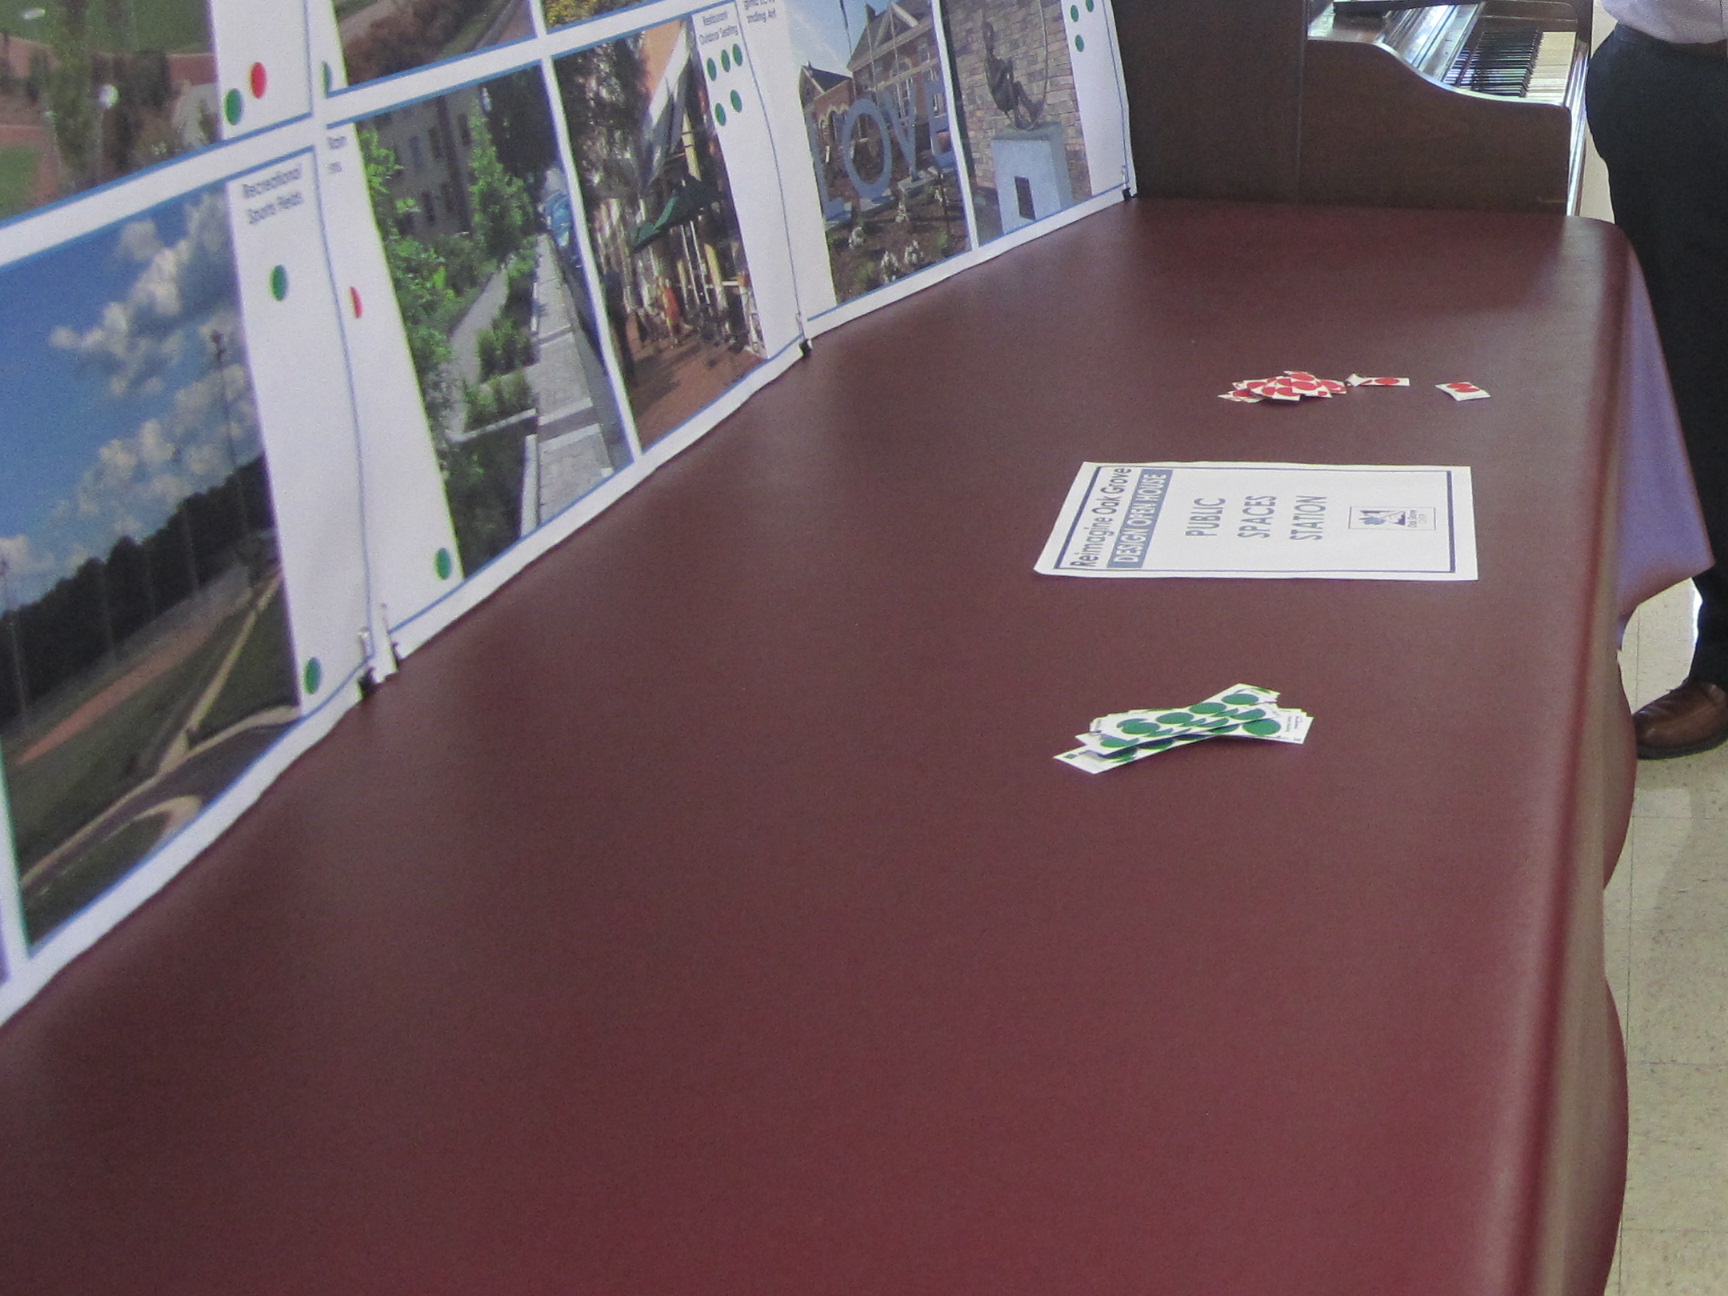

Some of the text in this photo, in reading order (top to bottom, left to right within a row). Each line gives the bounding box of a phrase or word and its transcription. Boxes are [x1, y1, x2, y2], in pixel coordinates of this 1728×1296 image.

[1070, 468, 1132, 567] Reimagine Oak Grove
[1113, 473, 1167, 562] DESIGN OPEN HOUSE
[1184, 497, 1226, 537] PUBLIC
[1236, 495, 1277, 538] SPACES
[1289, 495, 1328, 540] STATION
